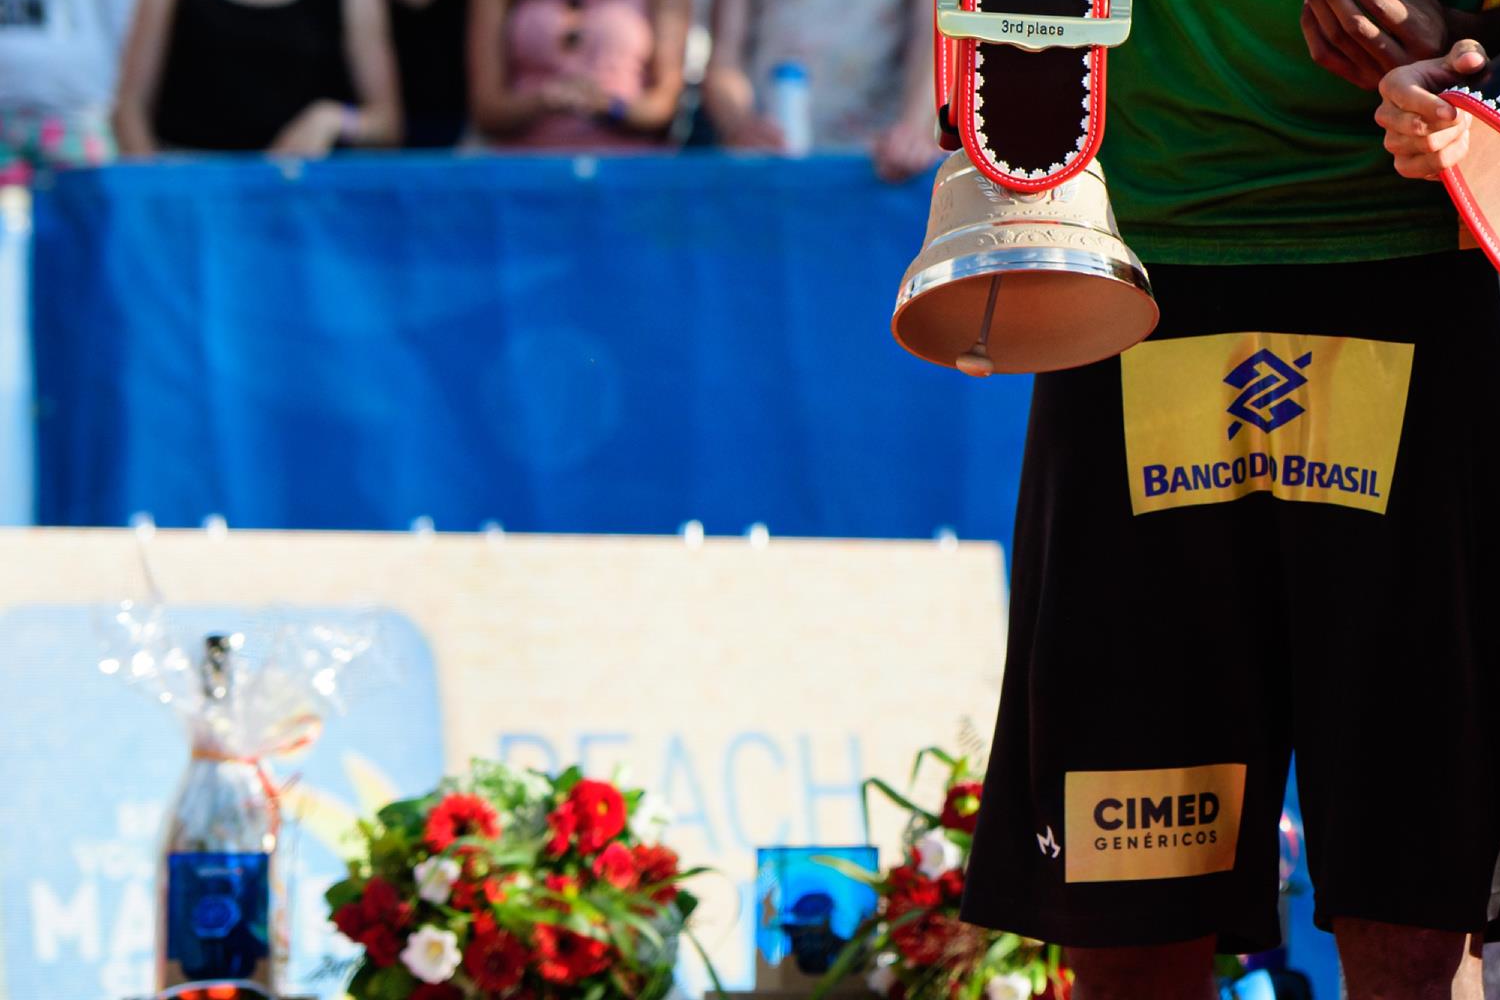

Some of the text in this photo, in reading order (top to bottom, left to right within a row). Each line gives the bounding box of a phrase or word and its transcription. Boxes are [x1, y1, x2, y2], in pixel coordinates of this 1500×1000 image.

[1001, 19, 1065, 38] 3rd place
[1142, 452, 1381, 498] BANCO DO BRASIL
[1093, 791, 1221, 831] CIMED
[1094, 830, 1218, 851] GENÉRICOS
